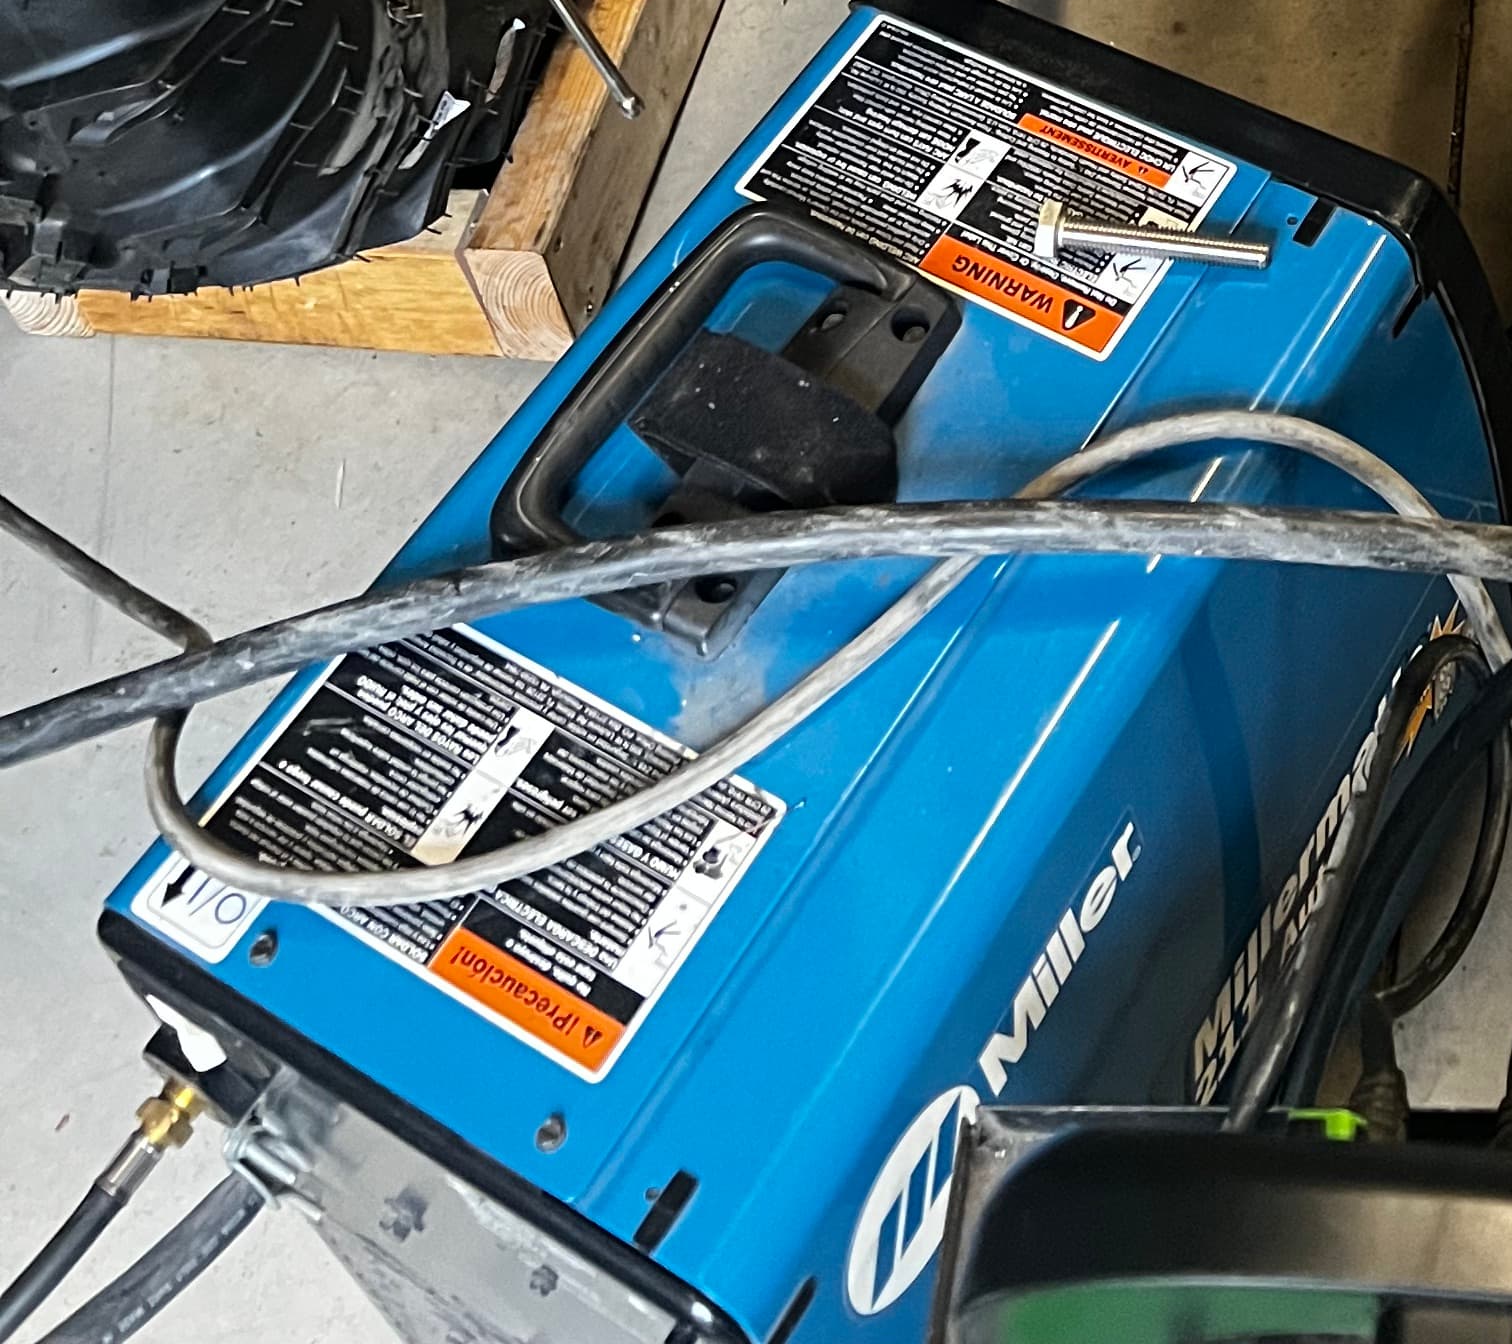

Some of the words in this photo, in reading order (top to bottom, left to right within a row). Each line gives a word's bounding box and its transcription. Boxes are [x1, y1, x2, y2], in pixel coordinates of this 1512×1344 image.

[1038, 123, 1132, 169] AVERTISSEMENT
[948, 254, 1057, 313] WARNING
[978, 822, 1142, 1096] Miller
[1195, 980, 1264, 1105] 211
